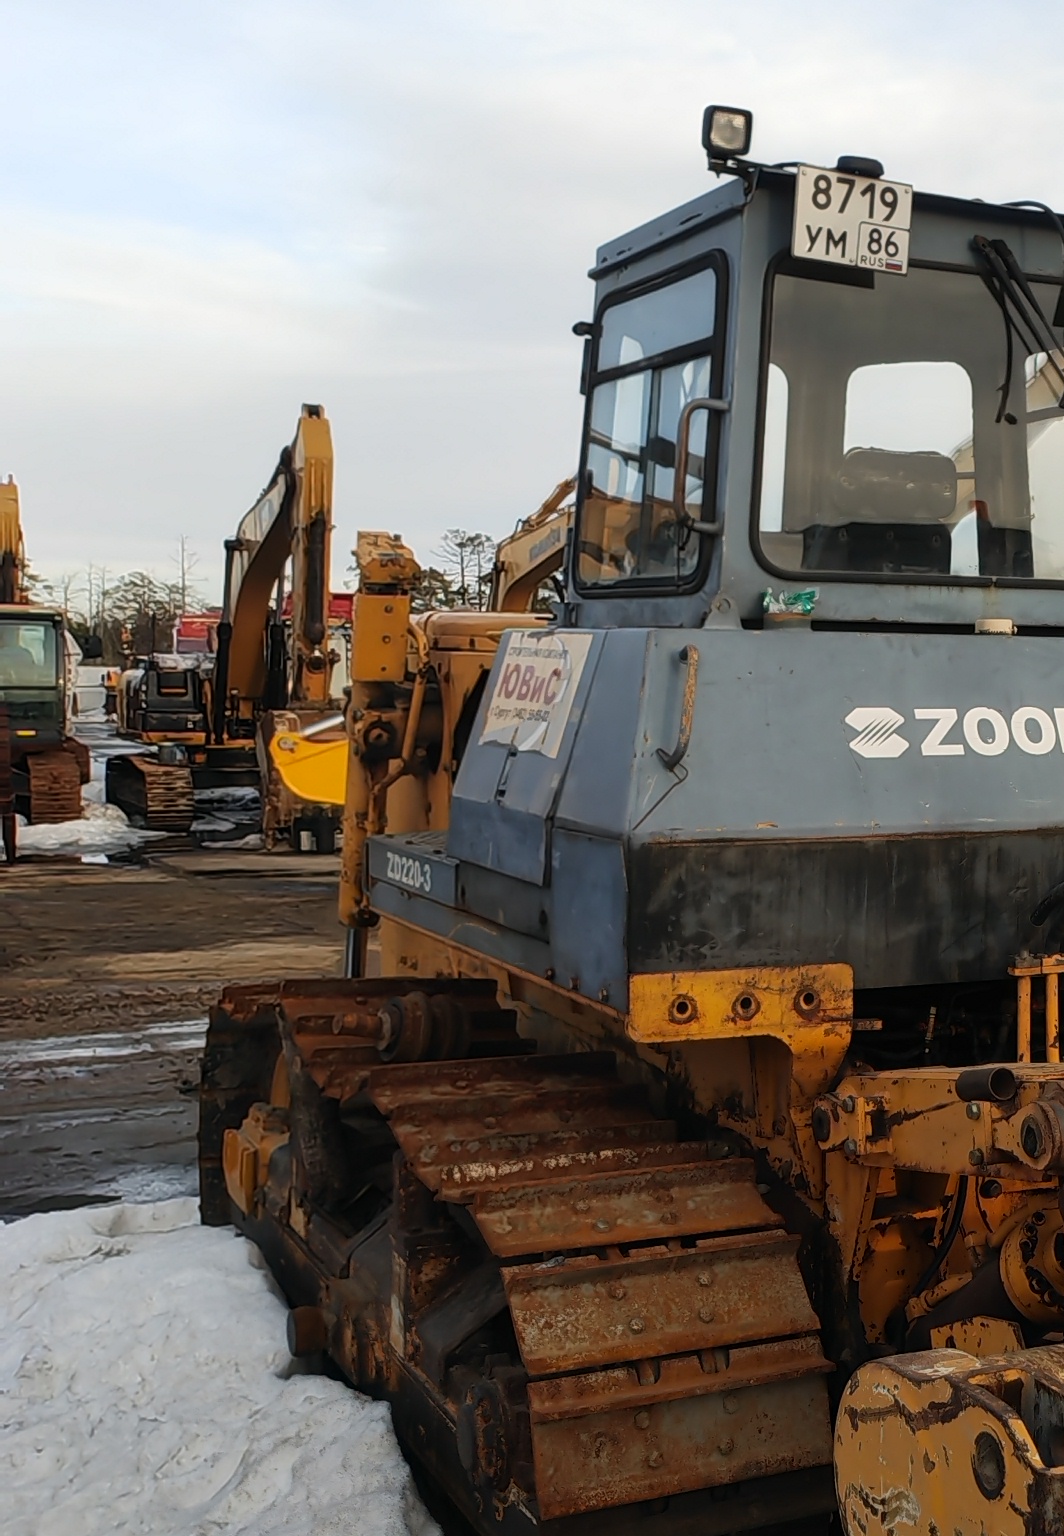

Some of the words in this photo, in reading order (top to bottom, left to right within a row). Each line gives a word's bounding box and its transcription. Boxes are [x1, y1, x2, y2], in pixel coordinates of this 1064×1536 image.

[812, 174, 898, 222] 8719
[867, 228, 899, 257] 86
[860, 255, 884, 268] RUS
[386, 851, 431, 892] ZD220-3
